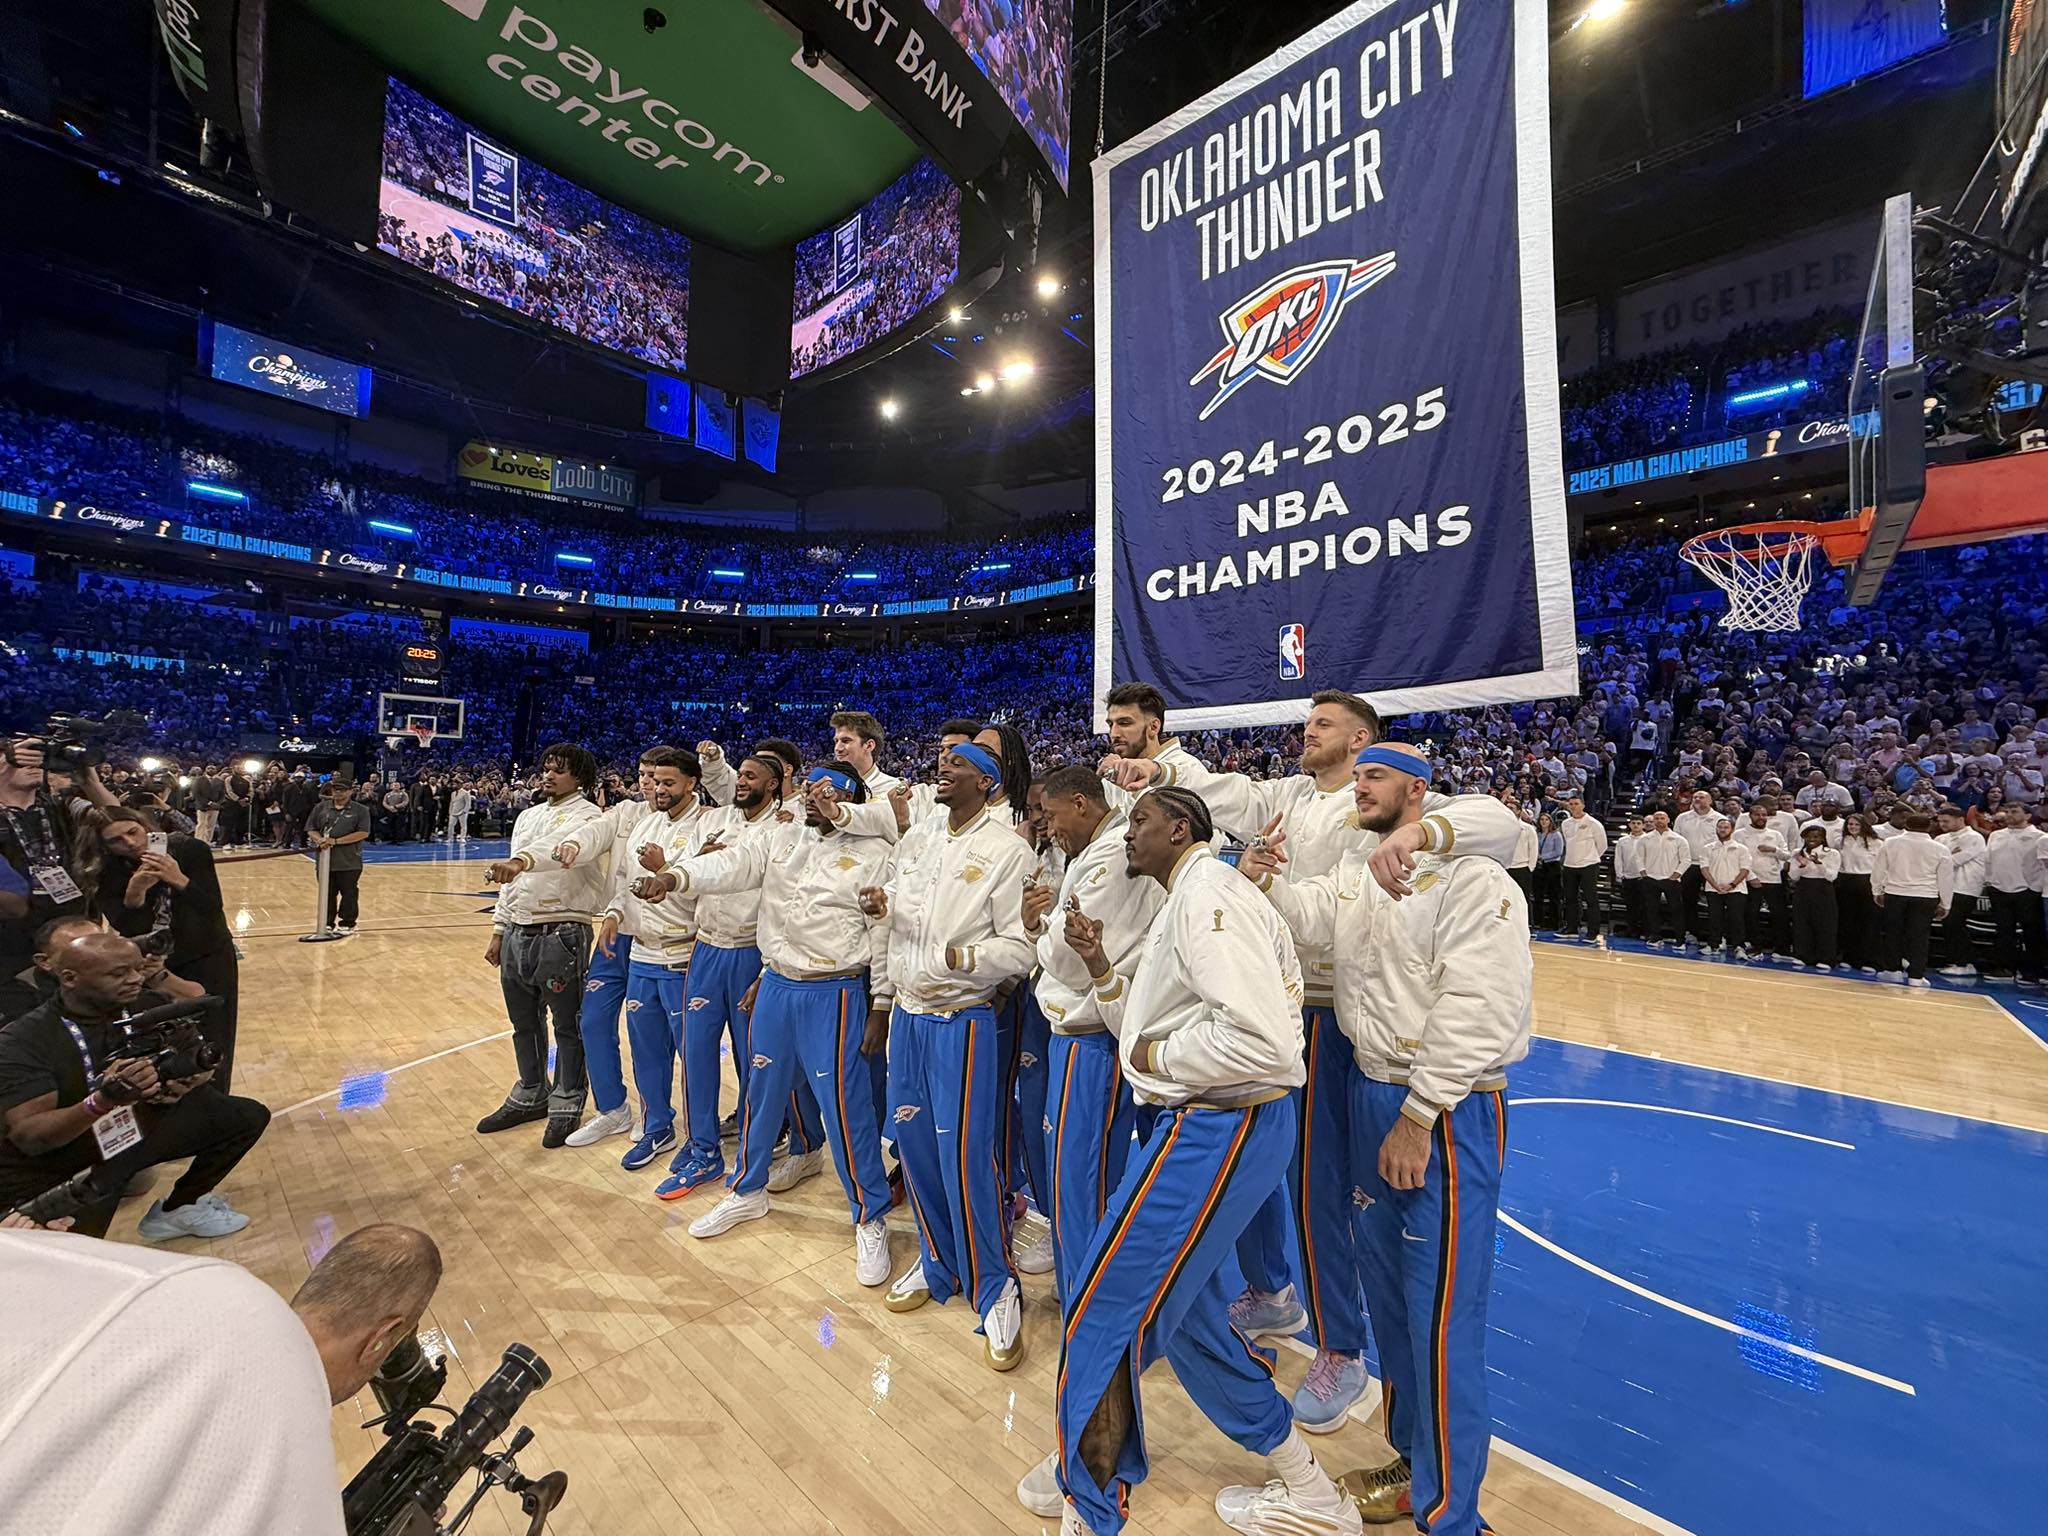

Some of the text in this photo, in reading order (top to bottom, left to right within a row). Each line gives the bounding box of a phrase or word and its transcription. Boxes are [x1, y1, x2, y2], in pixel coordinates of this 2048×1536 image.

[486, 54, 690, 170] center
[896, 28, 973, 128] BANK
[1140, 0, 1458, 232] OKLAHOMA CITY
[1196, 128, 1384, 281] THUNDER
[1228, 280, 1322, 377] OKC
[1640, 253, 1859, 339] TOGETHER
[248, 355, 328, 390] Champions
[555, 468, 595, 489] LOUD
[600, 473, 633, 501] CITY
[1161, 386, 1447, 503] 2024-2025
[1569, 466, 1610, 494] 2025
[1613, 459, 1645, 485] NBA
[1648, 438, 1748, 478] CHAMPIONS
[1798, 421, 1850, 444] Cham
[470, 481, 624, 513] BRING THE THUNDER EXIT NOW
[1237, 480, 1349, 538] NBA
[78, 506, 146, 530] Champions
[182, 525, 217, 545] 2025
[218, 532, 243, 550] NBA
[245, 536, 312, 561] CHAMPIONS
[339, 553, 388, 574] Champions
[414, 567, 440, 583] 2025
[441, 571, 459, 587] NBA
[461, 575, 512, 594] CHAMPIONS
[594, 592, 616, 607] 2025
[633, 596, 676, 610] CHAMPIONS
[747, 604, 765, 615] 2025
[780, 604, 818, 616] CHAMPIONS
[883, 602, 899, 615] 2025
[1010, 588, 1025, 603] 2025
[1145, 504, 1473, 602] CHAMPIONS
[407, 647, 437, 660] 20:25
[1283, 666, 1296, 677] NBA
